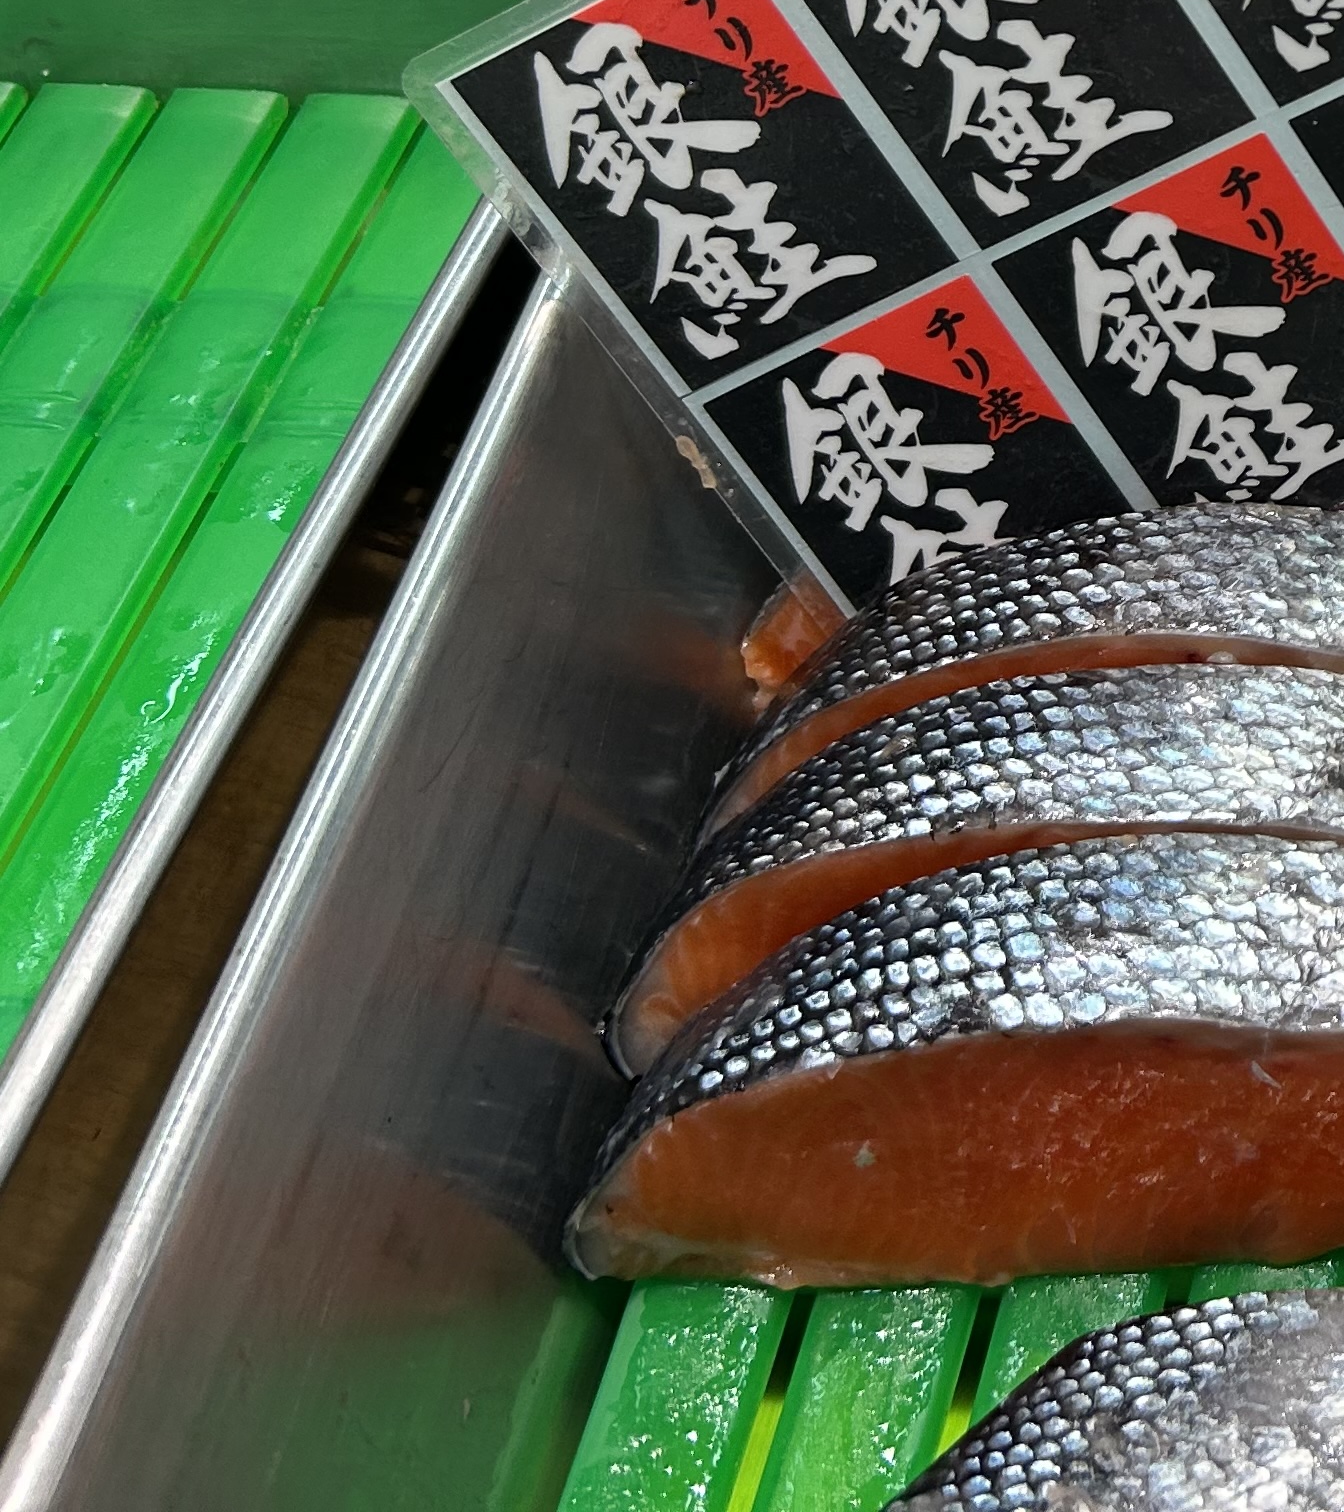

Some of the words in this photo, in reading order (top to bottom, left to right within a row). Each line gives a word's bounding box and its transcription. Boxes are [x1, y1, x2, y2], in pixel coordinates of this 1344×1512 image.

[533, 23, 878, 359] 銀鮭
[1220, 166, 1334, 303] チリ産
[925, 307, 1041, 440] チリ産
